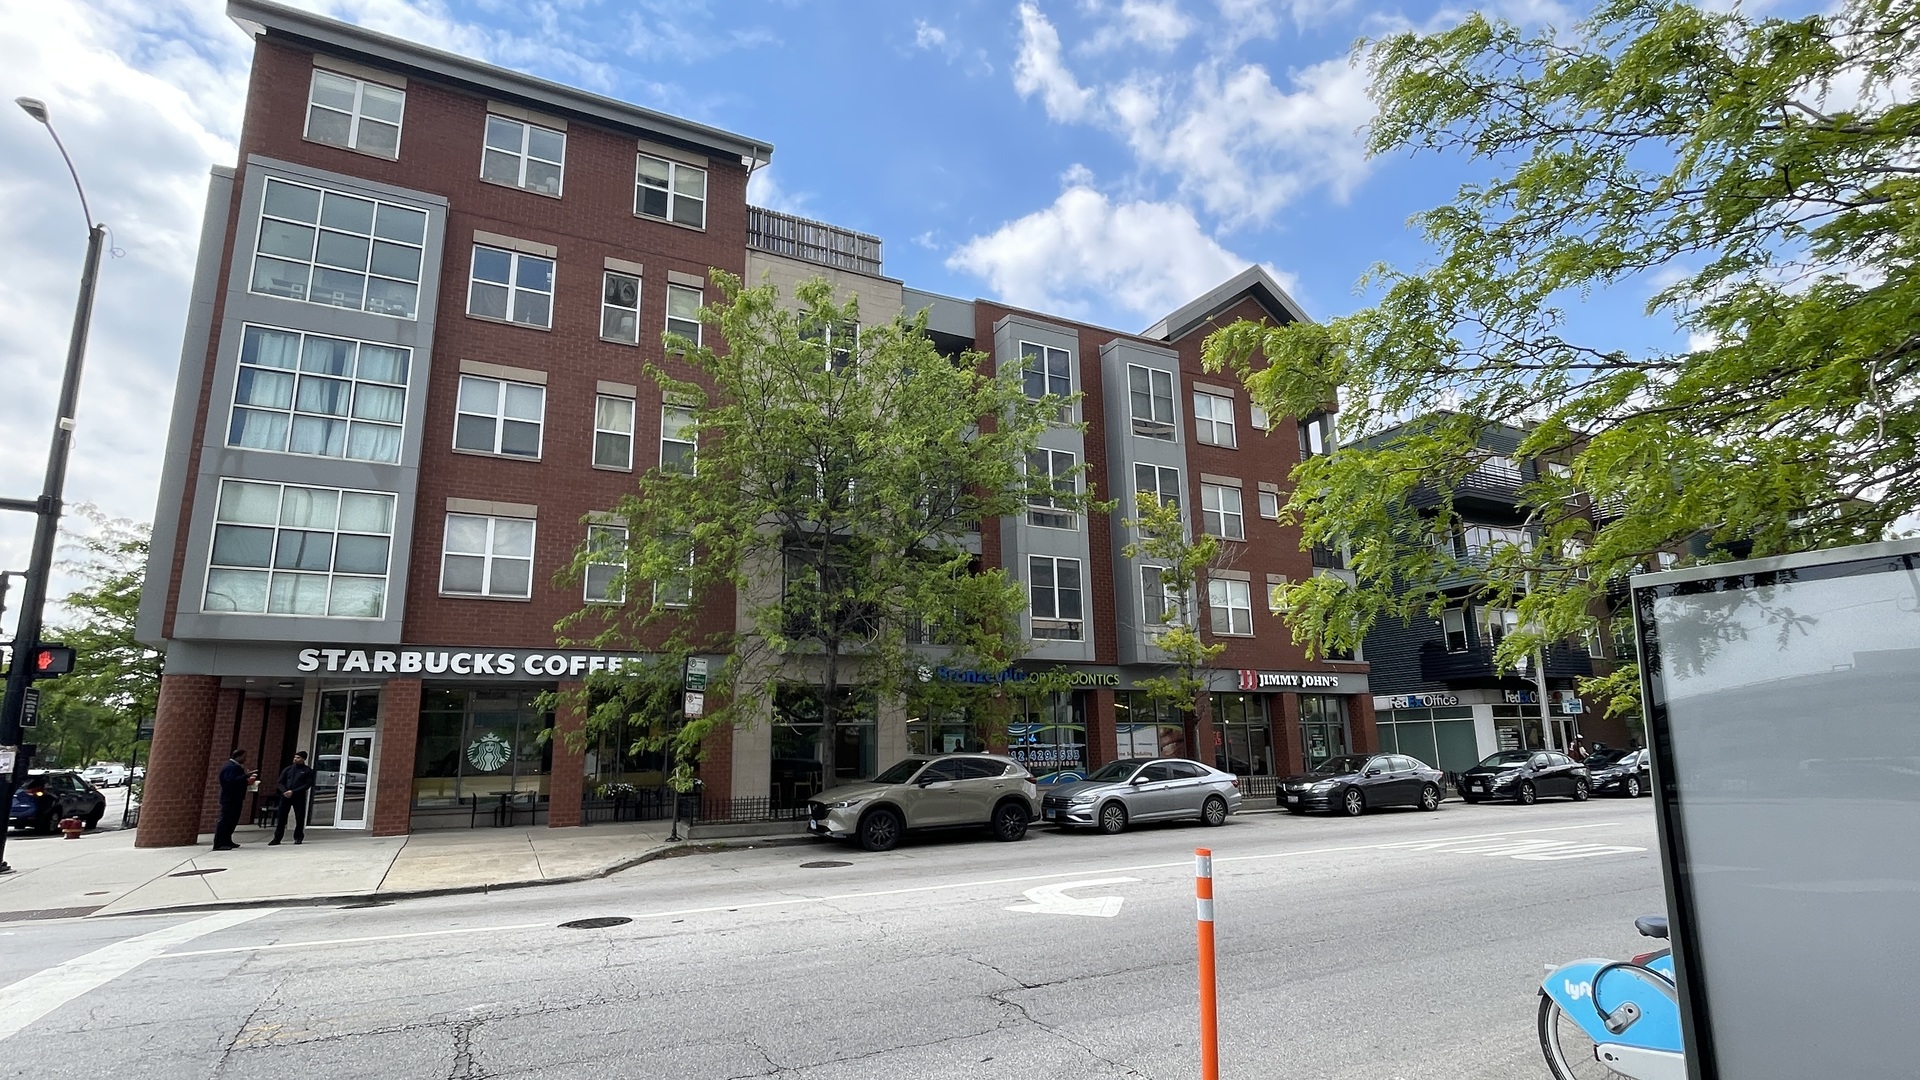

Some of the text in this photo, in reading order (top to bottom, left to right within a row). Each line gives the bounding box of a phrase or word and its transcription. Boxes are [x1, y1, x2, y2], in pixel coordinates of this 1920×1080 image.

[297, 648, 516, 675] STARBUCKS
[1259, 674, 1339, 688] JIMMY JOHN'S
[1389, 694, 1458, 709] FedEx Office
[1530, 690, 1552, 703] Ofe
